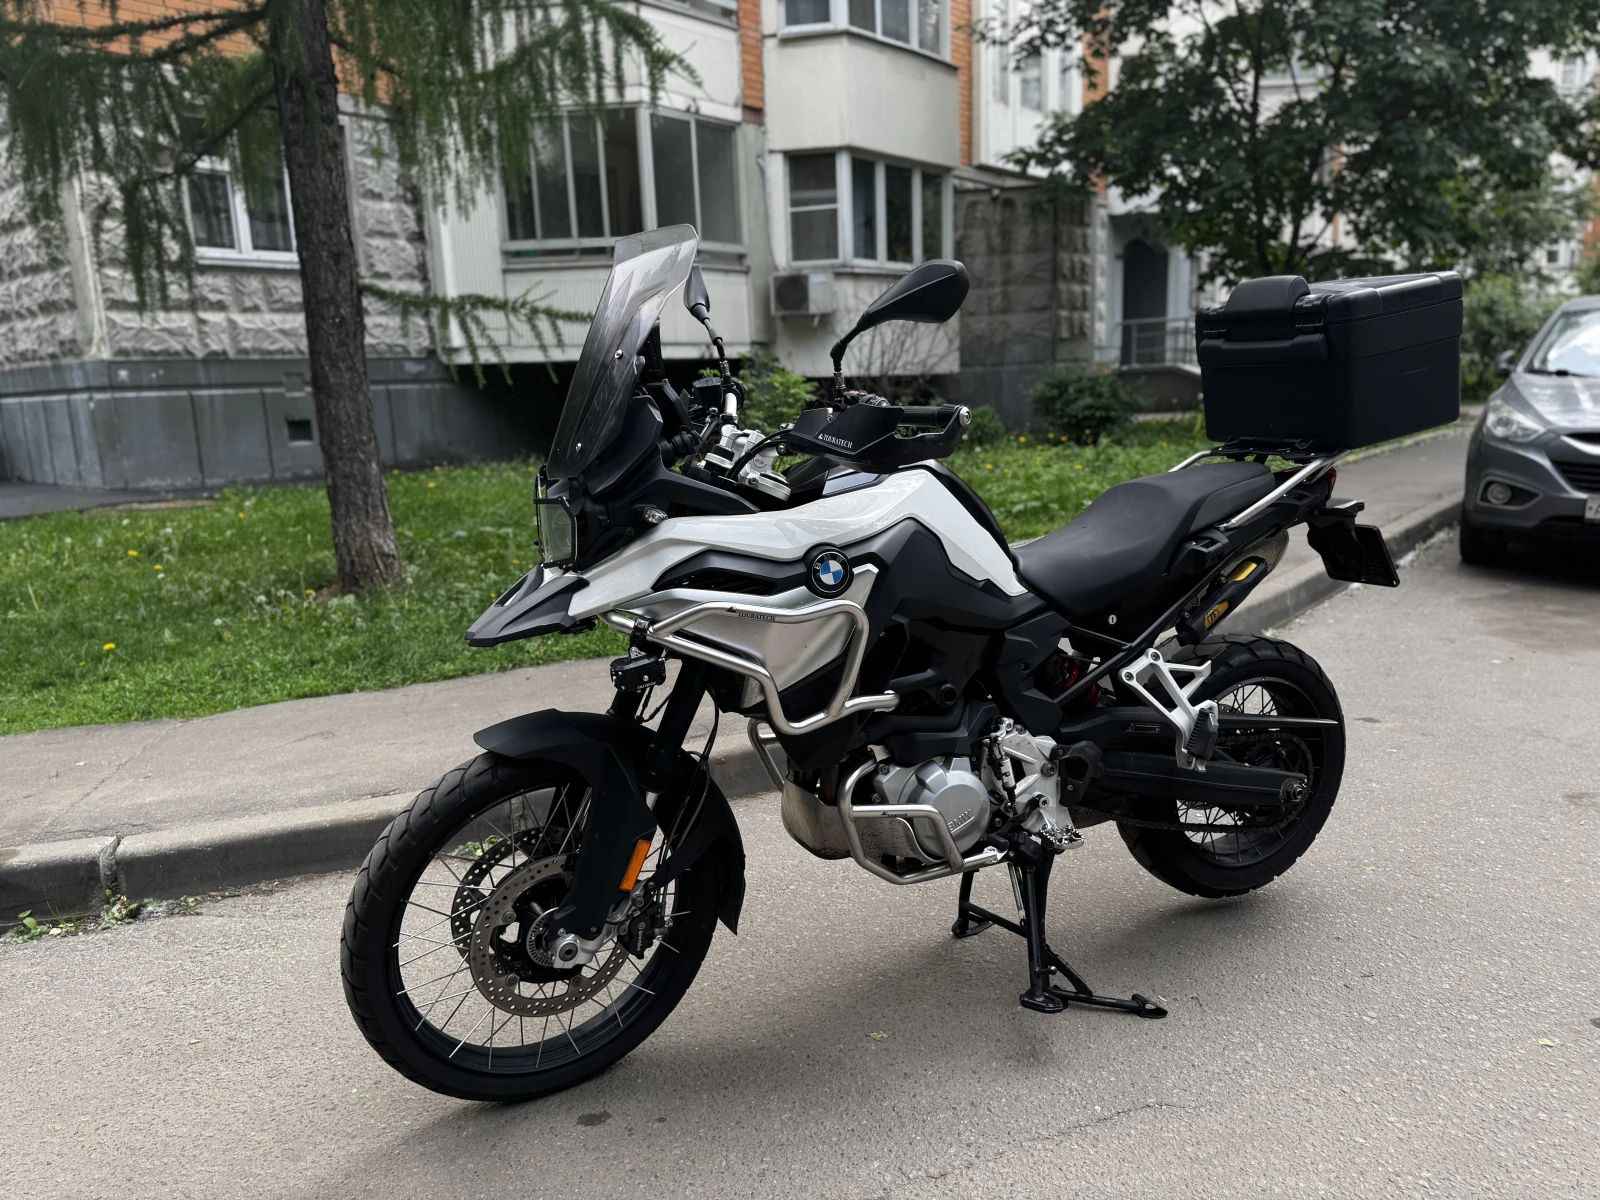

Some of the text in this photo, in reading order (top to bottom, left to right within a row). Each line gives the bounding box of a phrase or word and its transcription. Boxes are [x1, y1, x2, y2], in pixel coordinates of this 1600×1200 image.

[823, 433, 853, 449] TOURATECH
[814, 553, 844, 570] BMW
[737, 611, 775, 621] TOURATECH
[947, 808, 972, 832] BMW
